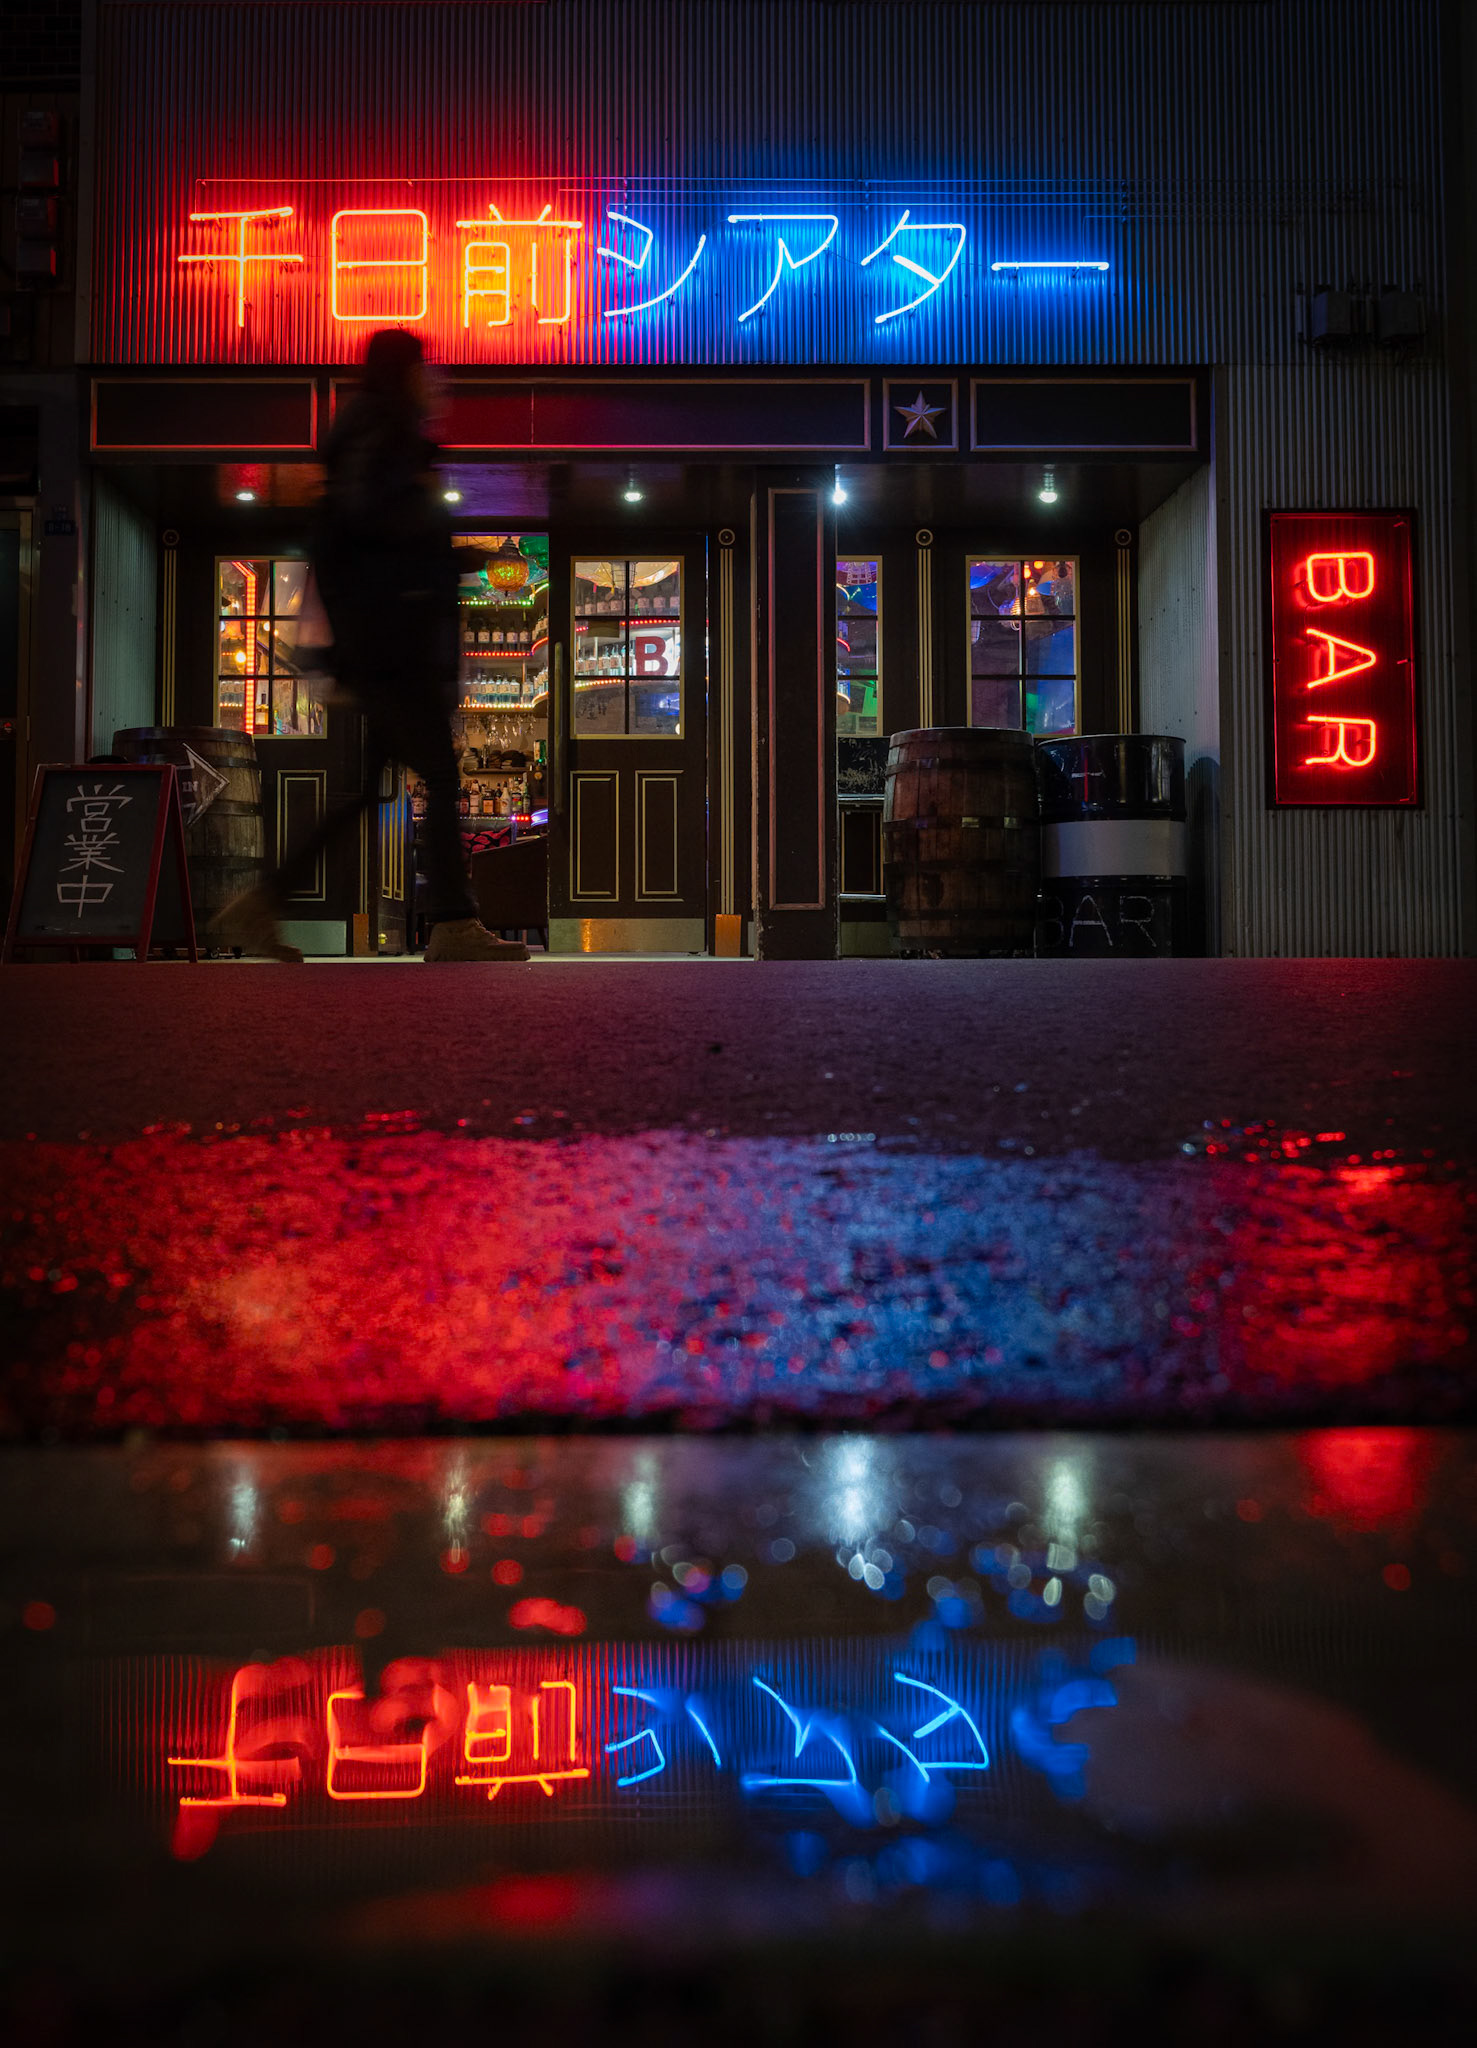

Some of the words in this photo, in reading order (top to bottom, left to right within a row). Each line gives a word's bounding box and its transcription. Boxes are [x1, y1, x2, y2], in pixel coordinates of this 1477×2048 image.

[177, 203, 1111, 328] 千日前シアター
[1306, 551, 1377, 767] BAR
[57, 784, 133, 919] 営業中
